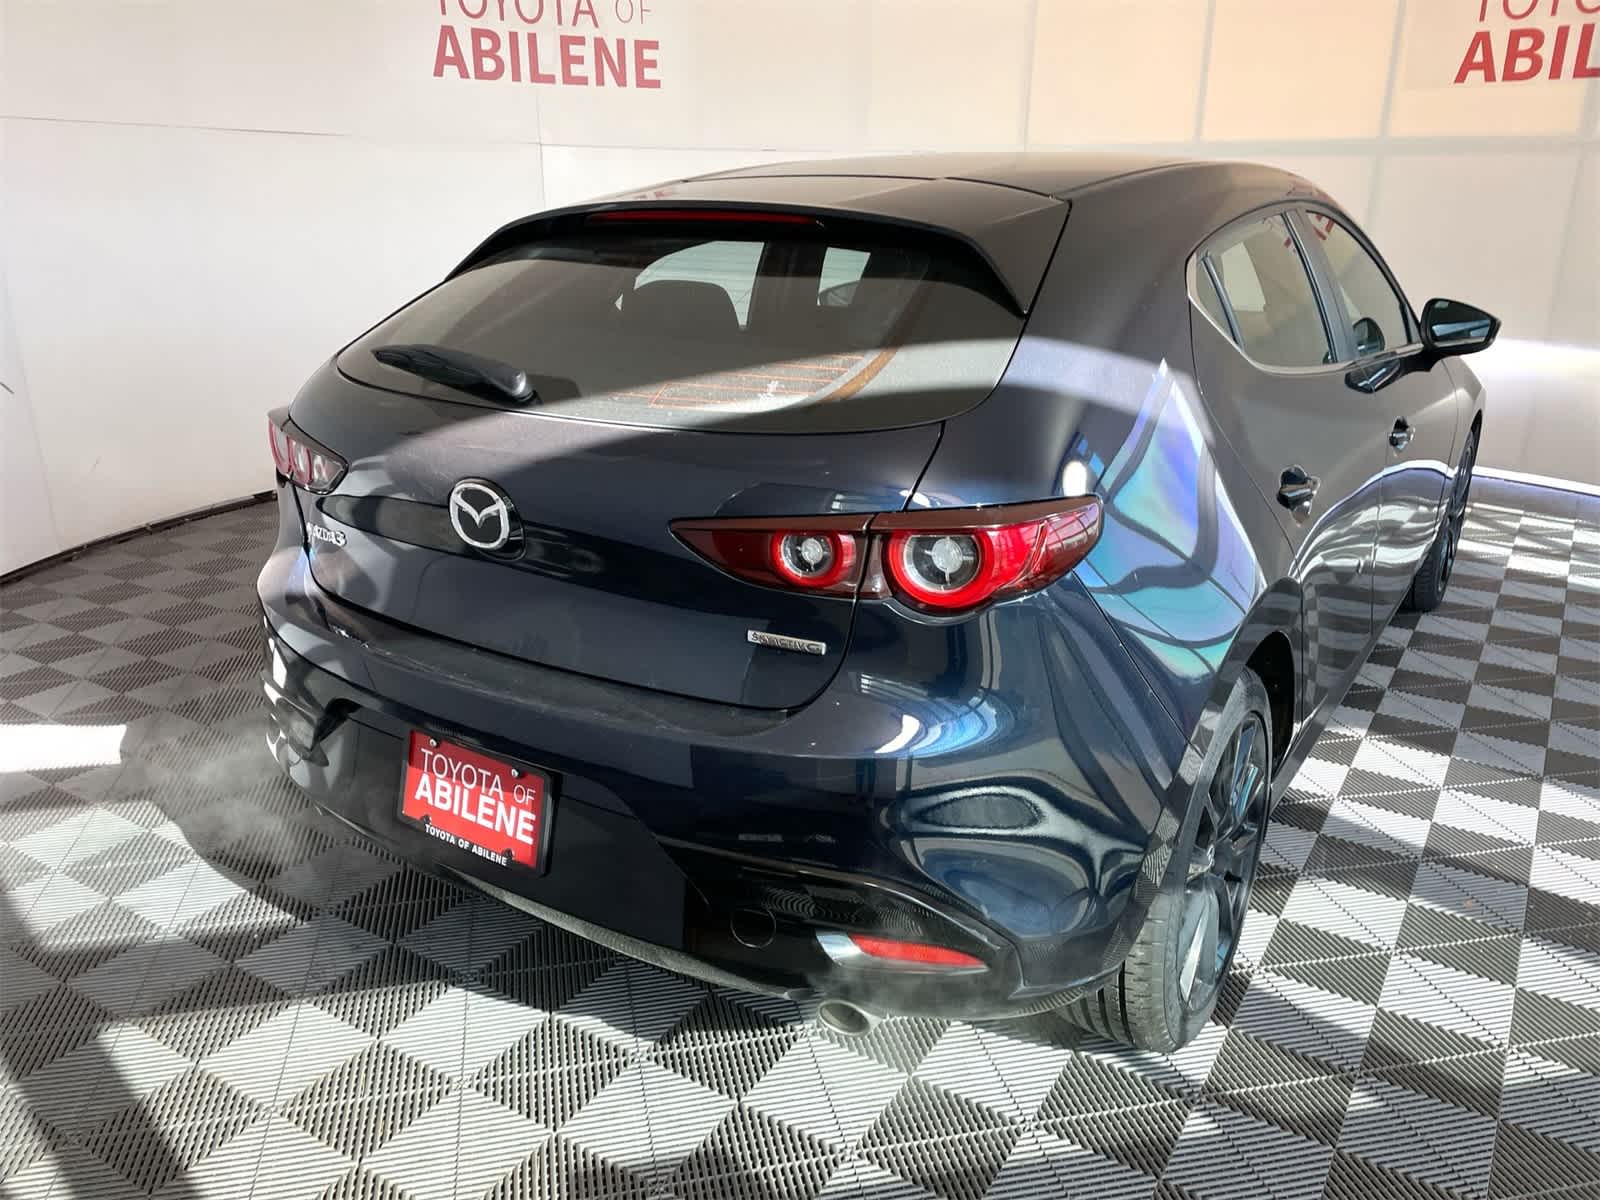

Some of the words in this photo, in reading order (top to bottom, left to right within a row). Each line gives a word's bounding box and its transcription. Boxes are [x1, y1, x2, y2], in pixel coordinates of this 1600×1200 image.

[433, 24, 662, 89] ABILENE
[420, 748, 504, 801] TOYOTA
[513, 784, 536, 806] OF
[414, 773, 536, 846] ABILENE
[424, 823, 456, 845] TOYOTA
[457, 838, 470, 850] OF
[471, 844, 508, 867] ABILENE
